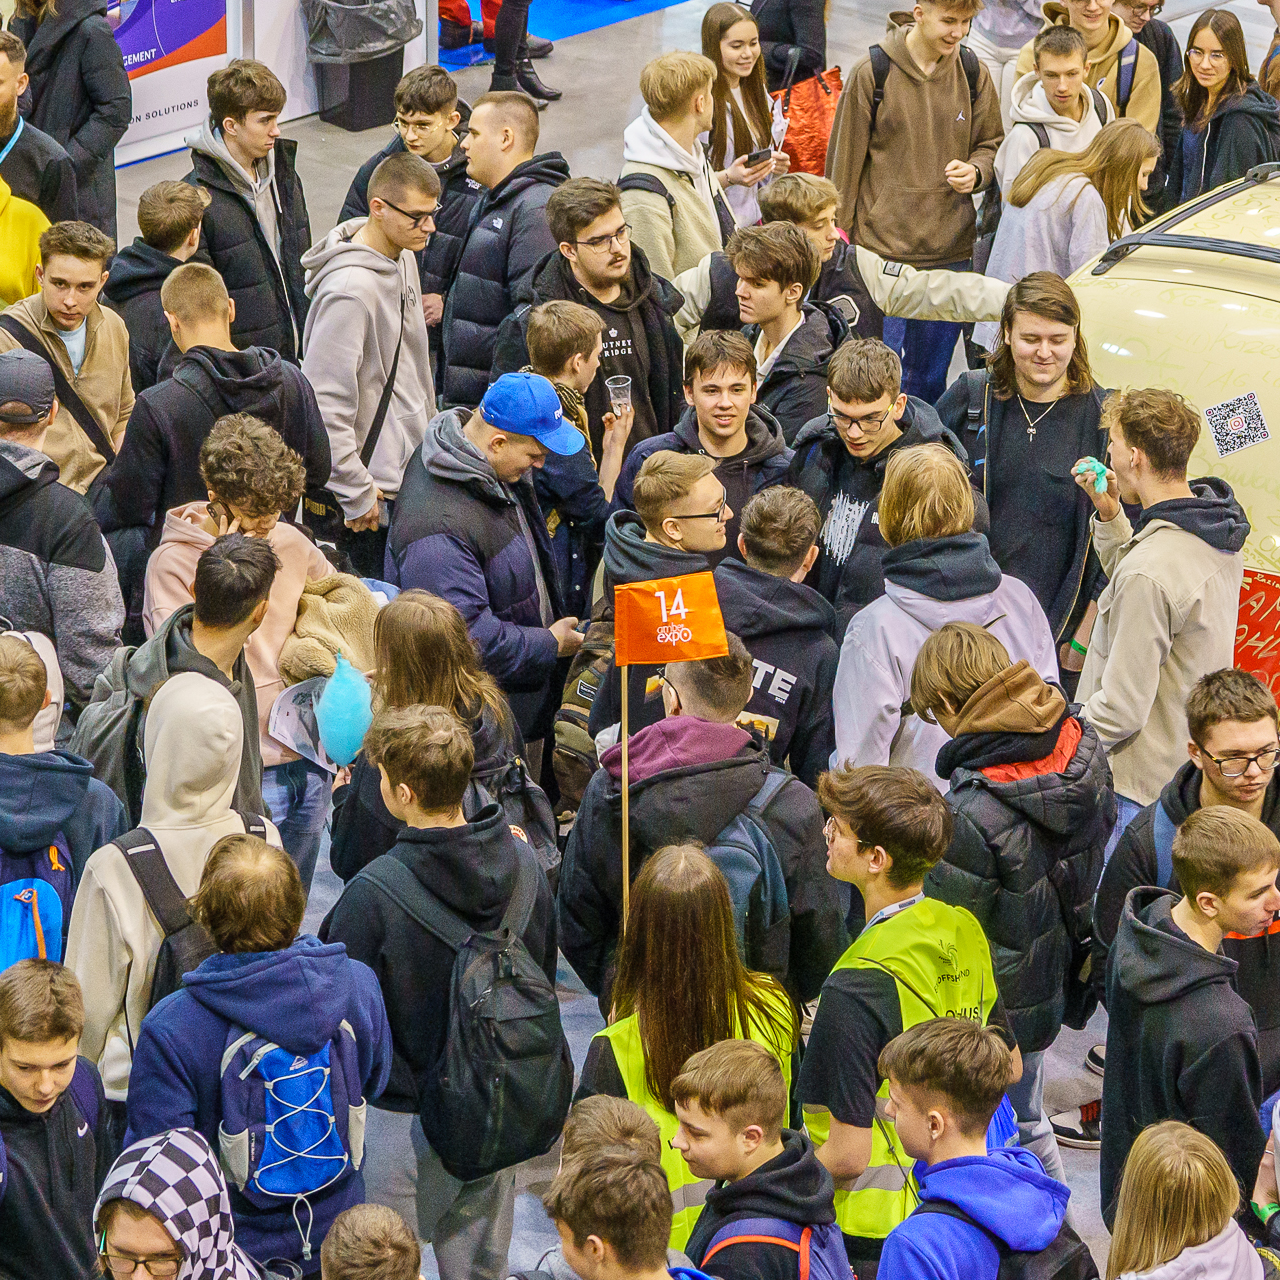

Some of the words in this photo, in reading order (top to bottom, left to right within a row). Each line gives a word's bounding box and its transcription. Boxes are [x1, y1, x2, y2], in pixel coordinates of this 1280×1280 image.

[145, 99, 199, 122] SOLUTIONS
[304, 498, 326, 516] PUMA
[654, 587, 689, 623] 14
[657, 628, 692, 646] expo
